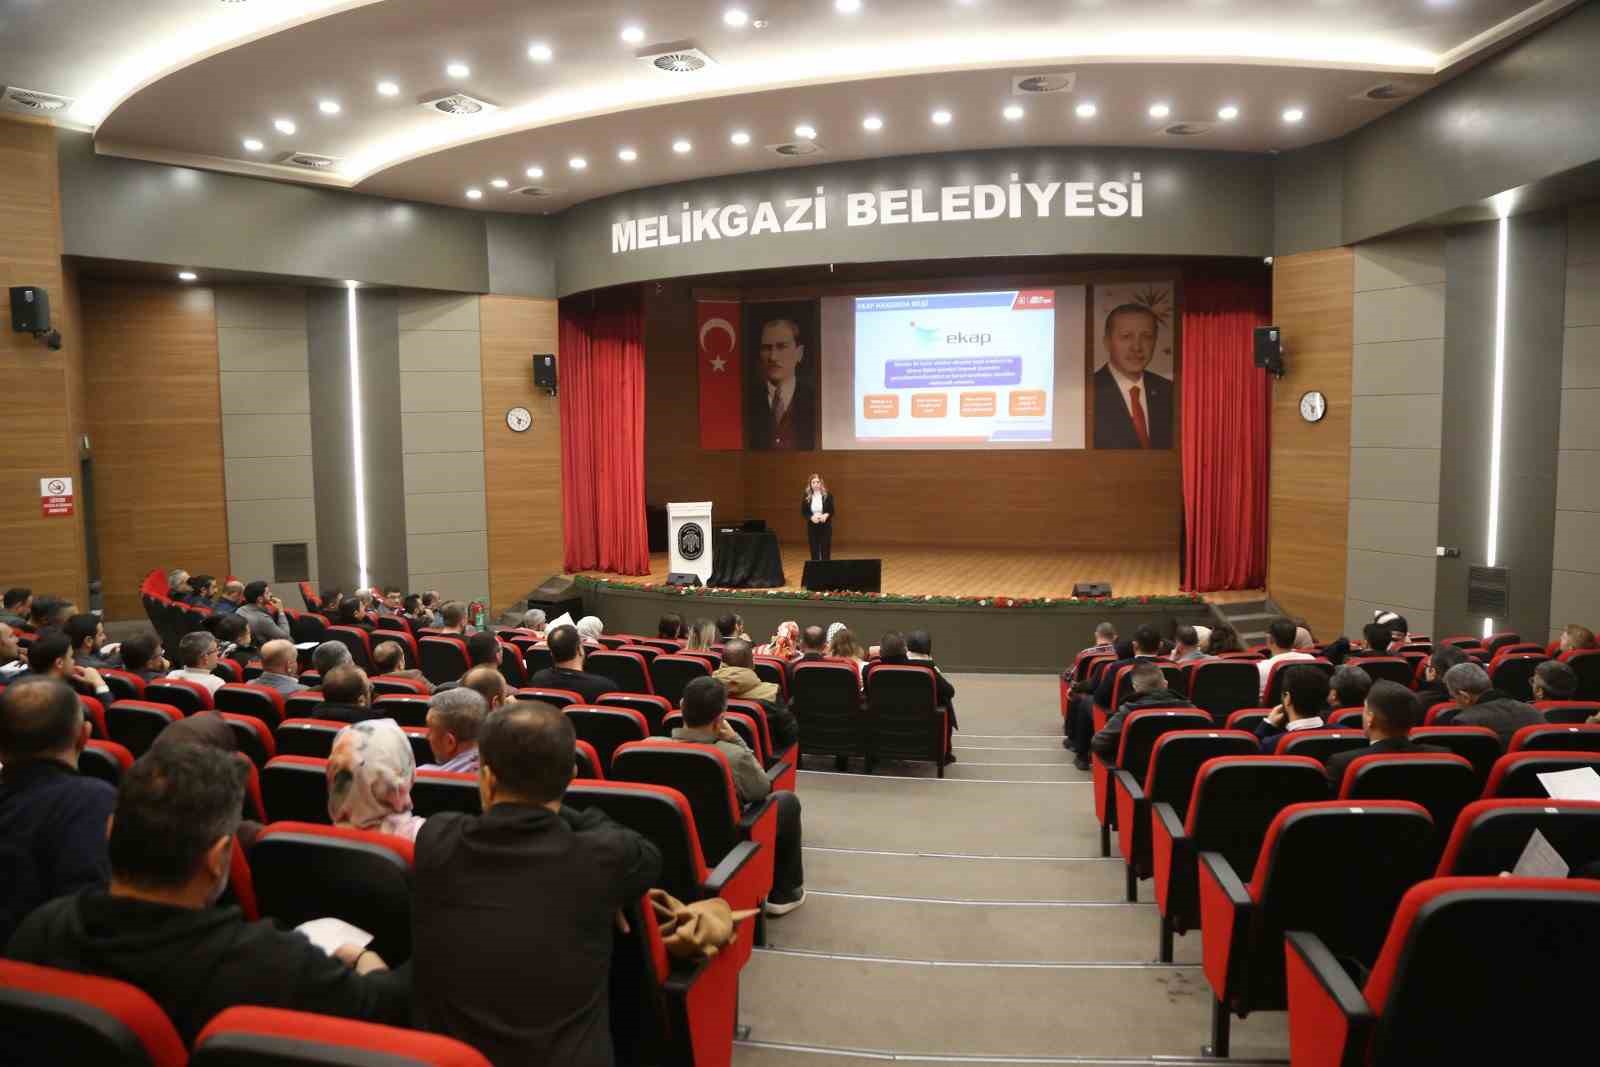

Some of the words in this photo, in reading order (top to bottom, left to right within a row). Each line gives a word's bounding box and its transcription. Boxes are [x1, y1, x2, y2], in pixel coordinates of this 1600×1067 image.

[611, 186, 827, 253] MELİKGAZİ
[847, 172, 1144, 226] BELEDİYESİ
[946, 331, 992, 346] ekap
